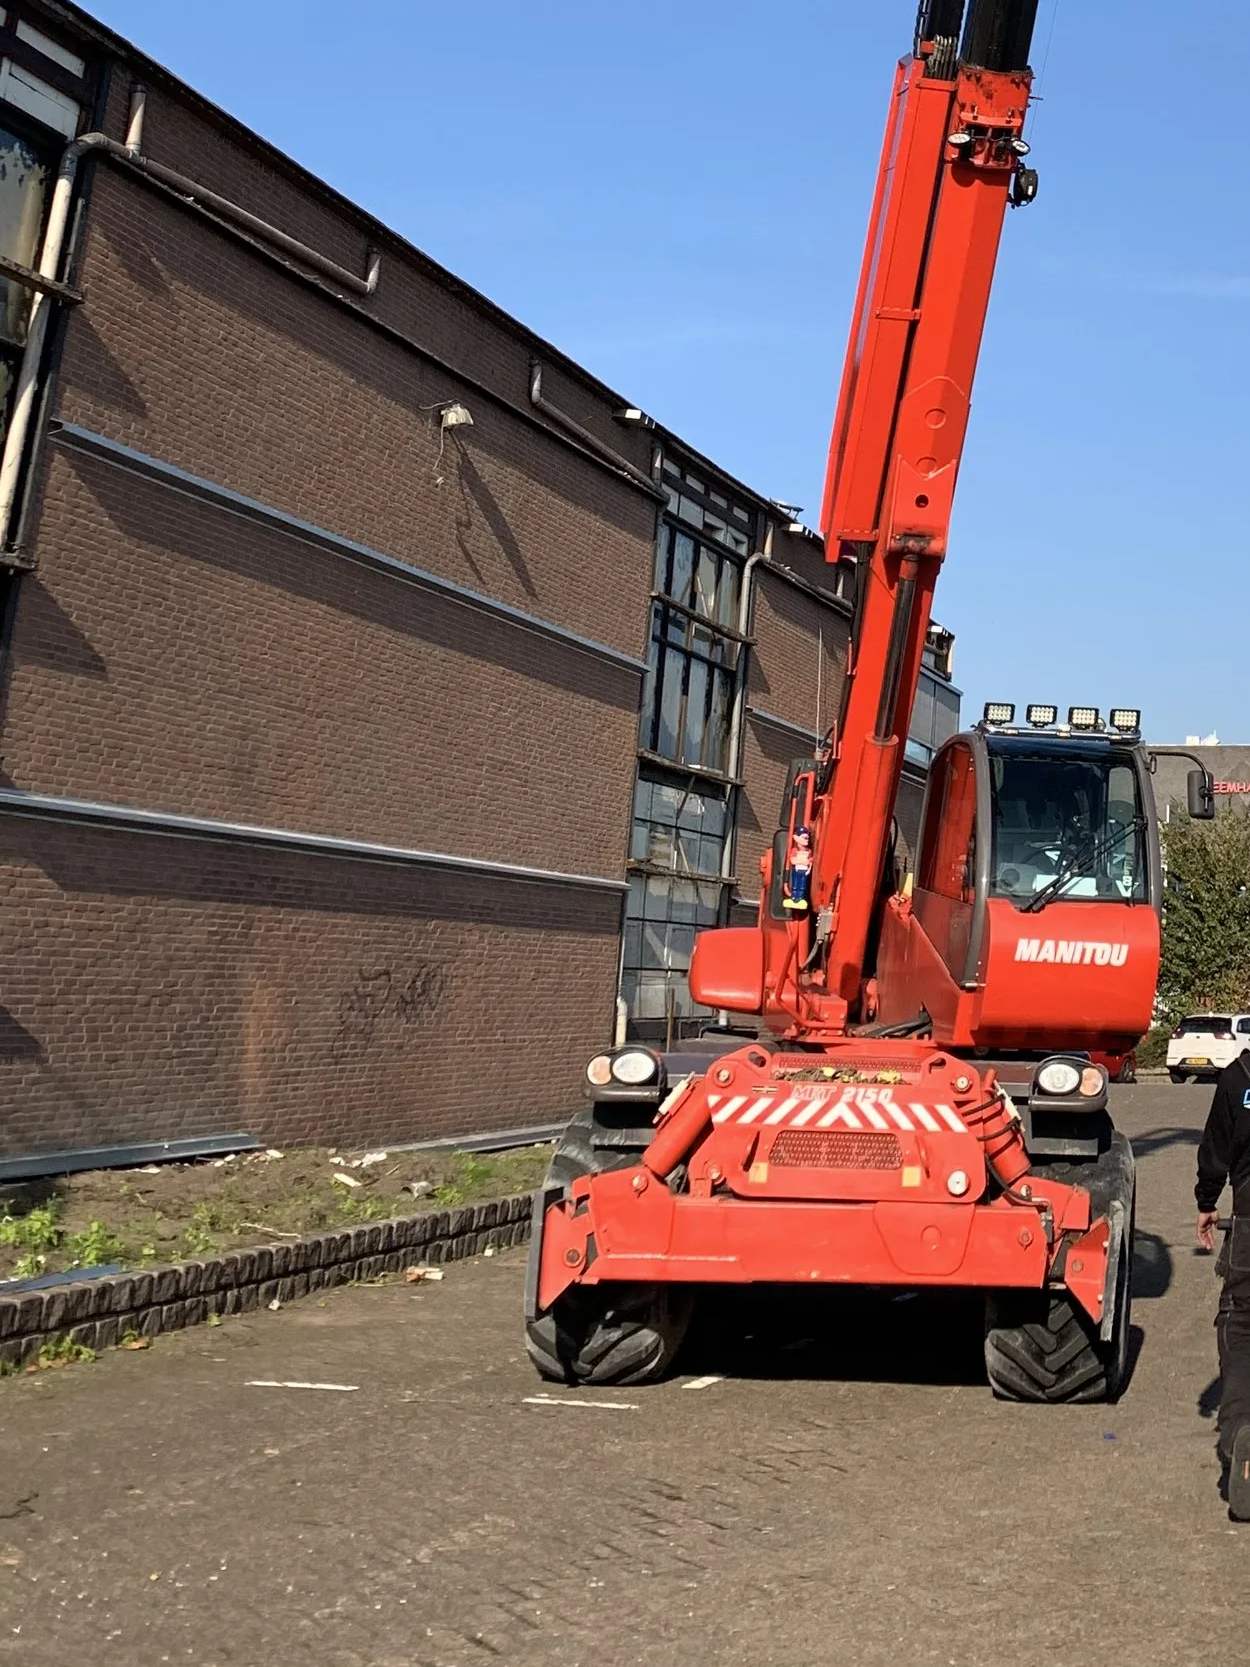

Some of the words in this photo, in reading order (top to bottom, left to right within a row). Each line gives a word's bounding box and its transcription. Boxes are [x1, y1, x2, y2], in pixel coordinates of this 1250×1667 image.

[1014, 938, 1129, 967] MANITOU
[791, 1085, 837, 1101] MRT
[840, 1087, 894, 1103] 2150
